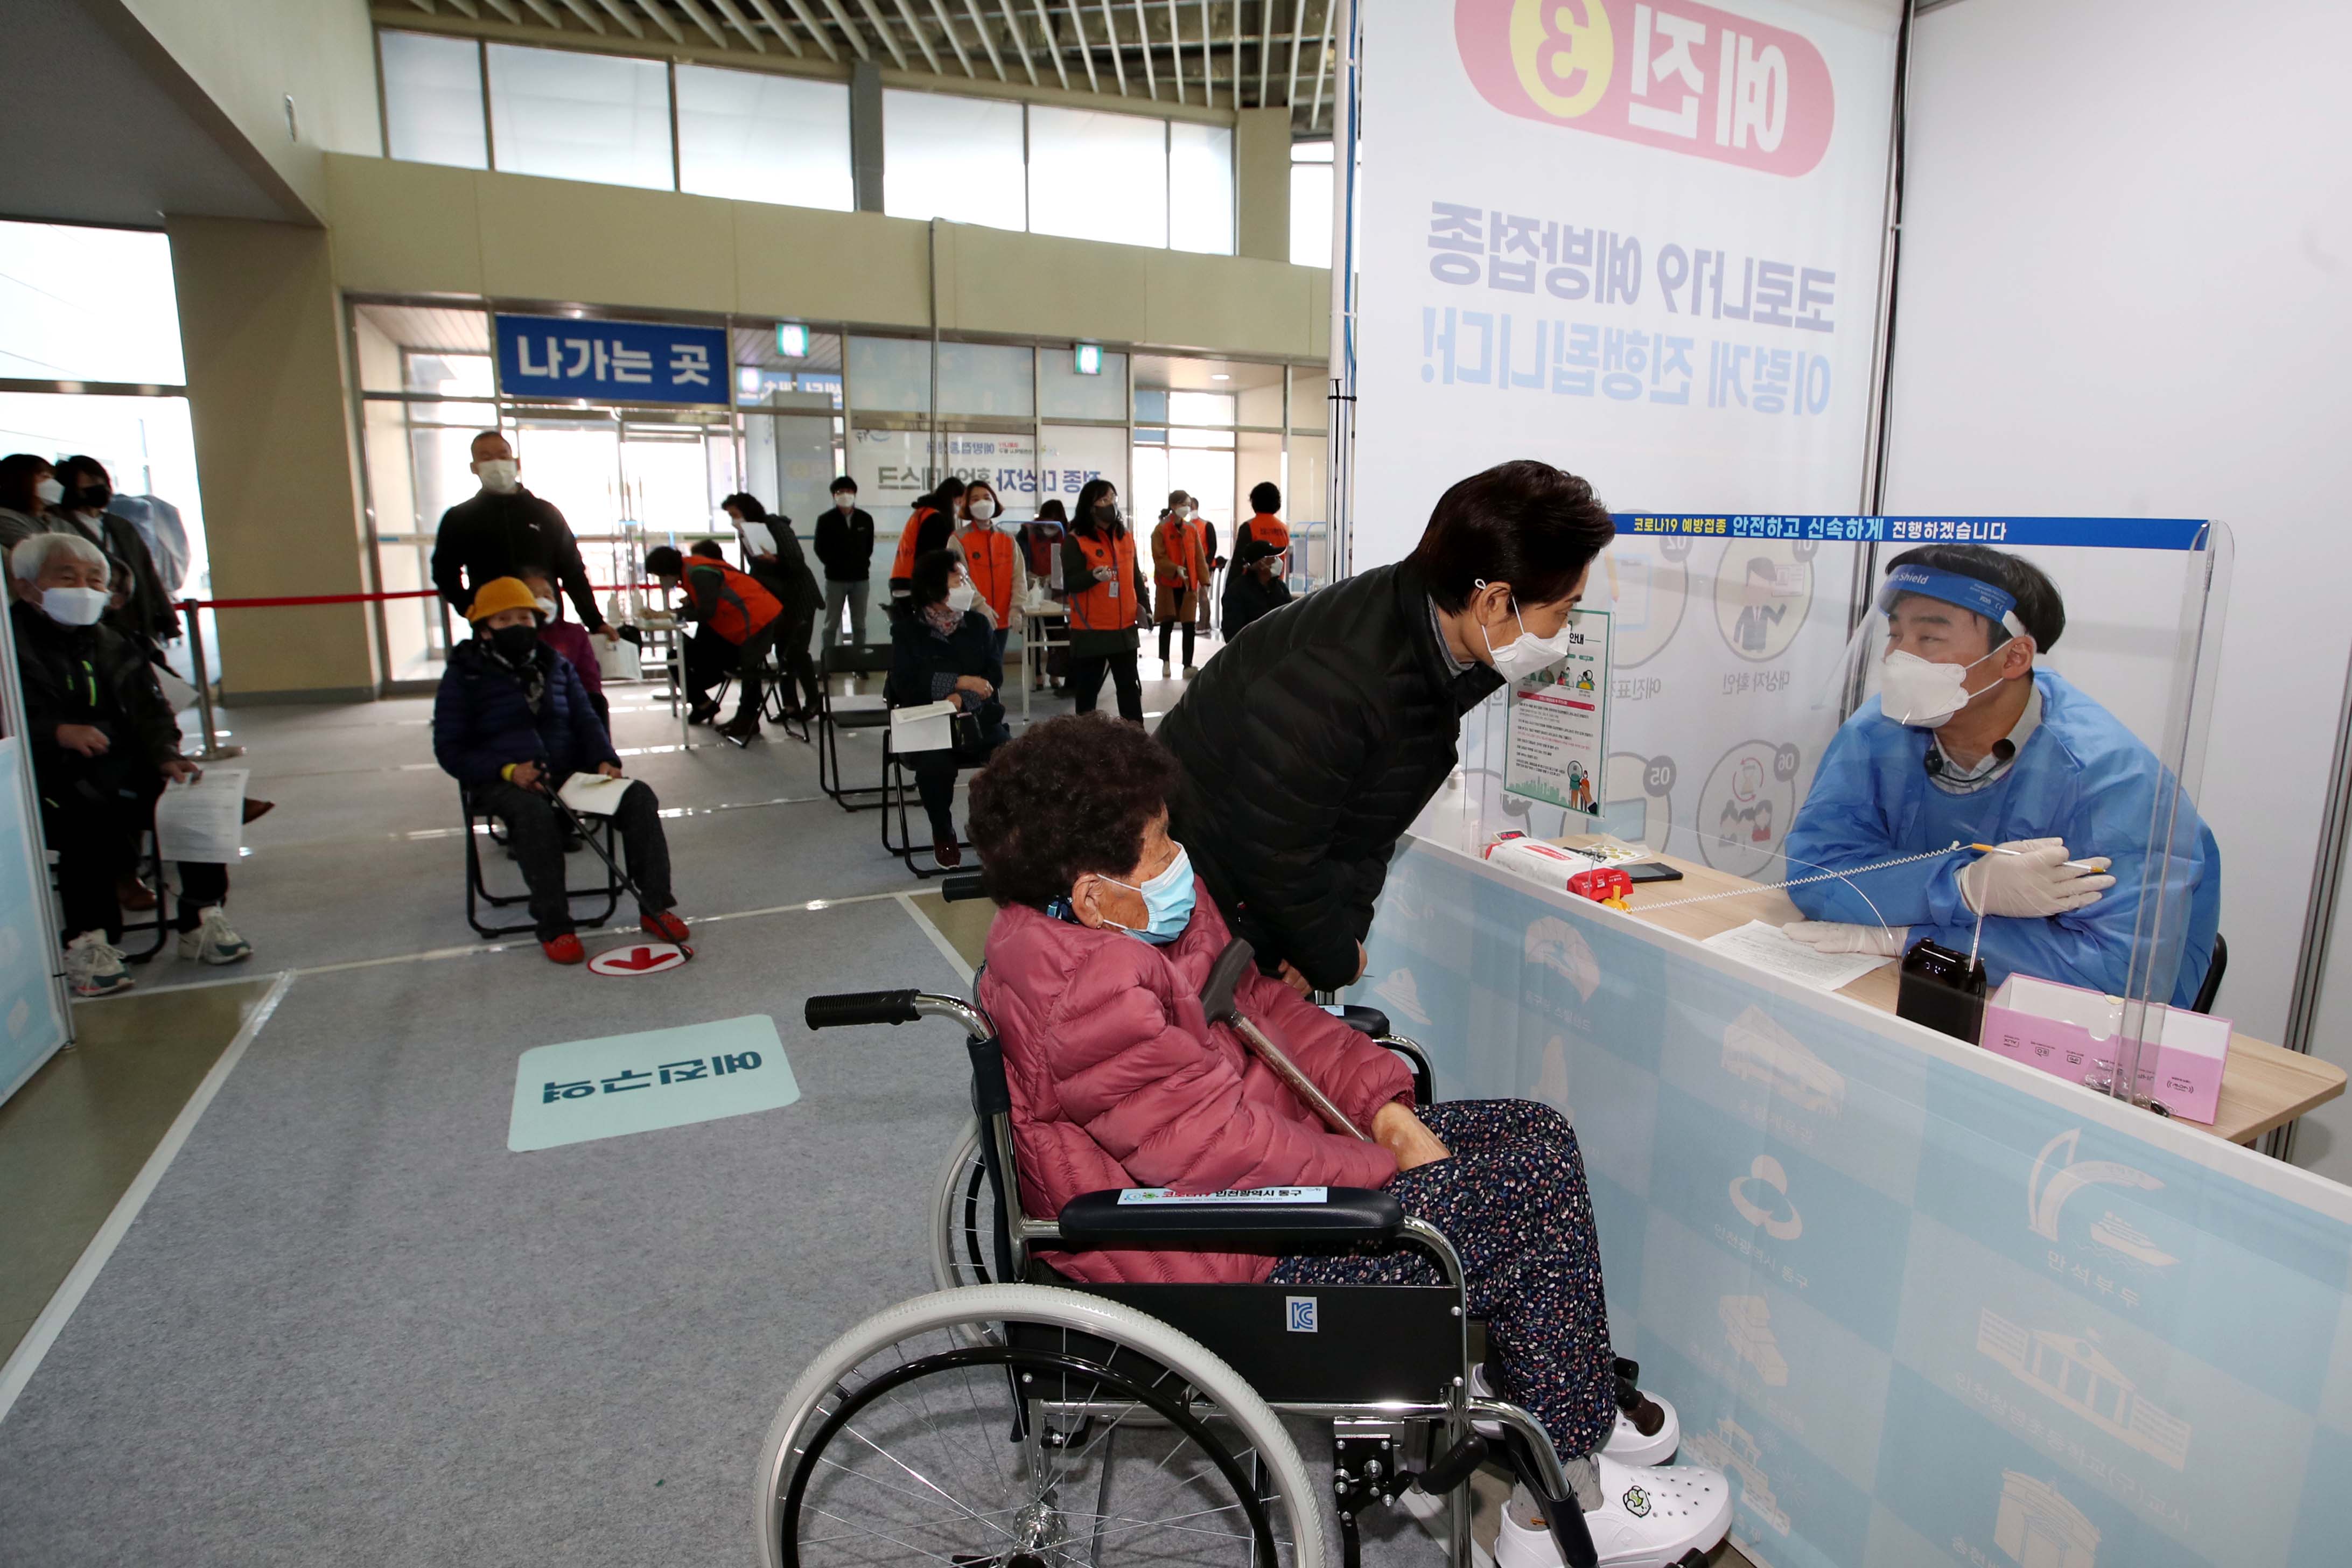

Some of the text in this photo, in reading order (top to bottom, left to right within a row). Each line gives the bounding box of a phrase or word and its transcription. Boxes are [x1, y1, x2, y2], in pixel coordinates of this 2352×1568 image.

[517, 335, 710, 386] 나가는 곳
[1633, 516, 2007, 541] 코로나19 예방접종 안전하고 신속하게 진행하겠습니다
[1899, 572, 1929, 585] Shield
[543, 1051, 762, 1104] 예진구역
[1215, 1189, 1275, 1198] 인천광역시
[1278, 1189, 1302, 1197] 동구
[1714, 1223, 1809, 1289] 인천광역시 동구
[2047, 1249, 2141, 1309] 만석부두
[1292, 1302, 1313, 1330] KC
